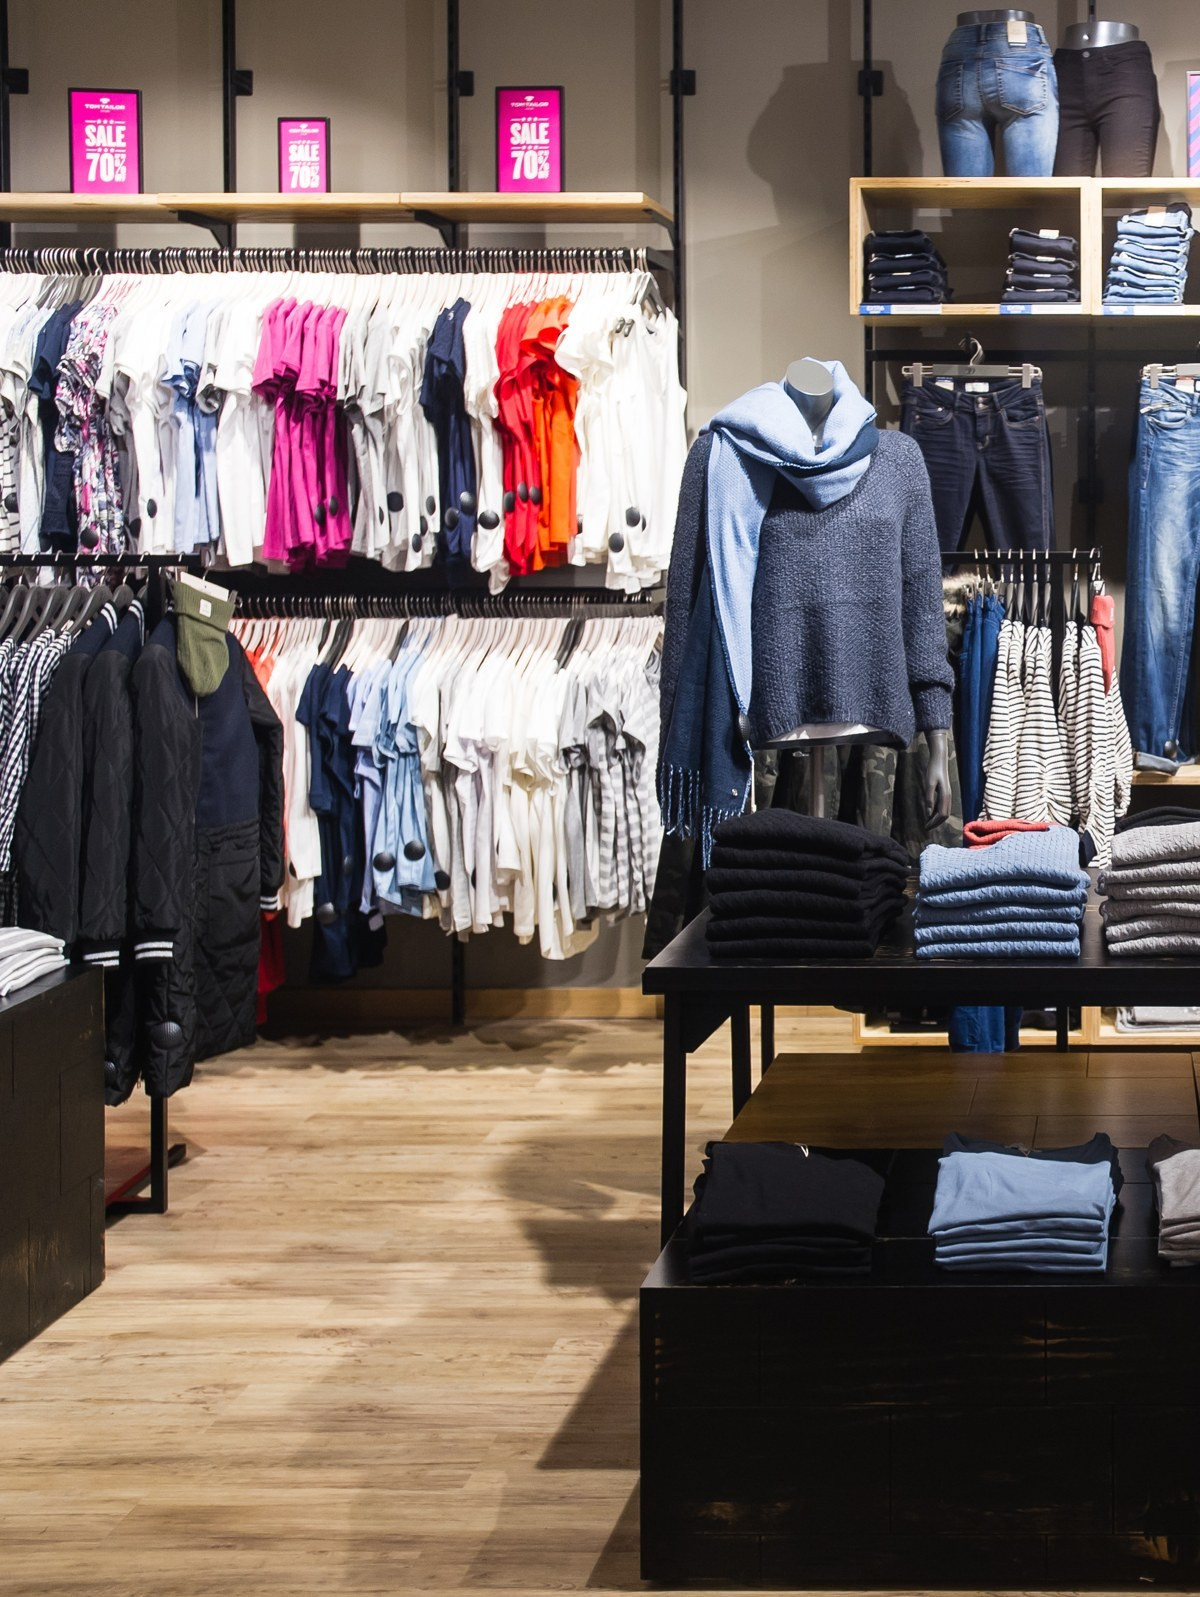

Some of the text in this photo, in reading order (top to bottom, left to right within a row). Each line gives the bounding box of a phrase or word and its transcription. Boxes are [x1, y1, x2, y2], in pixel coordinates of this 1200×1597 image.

[85, 124, 126, 147] SALE
[510, 122, 550, 145] SALE
[288, 144, 320, 162] SALE
